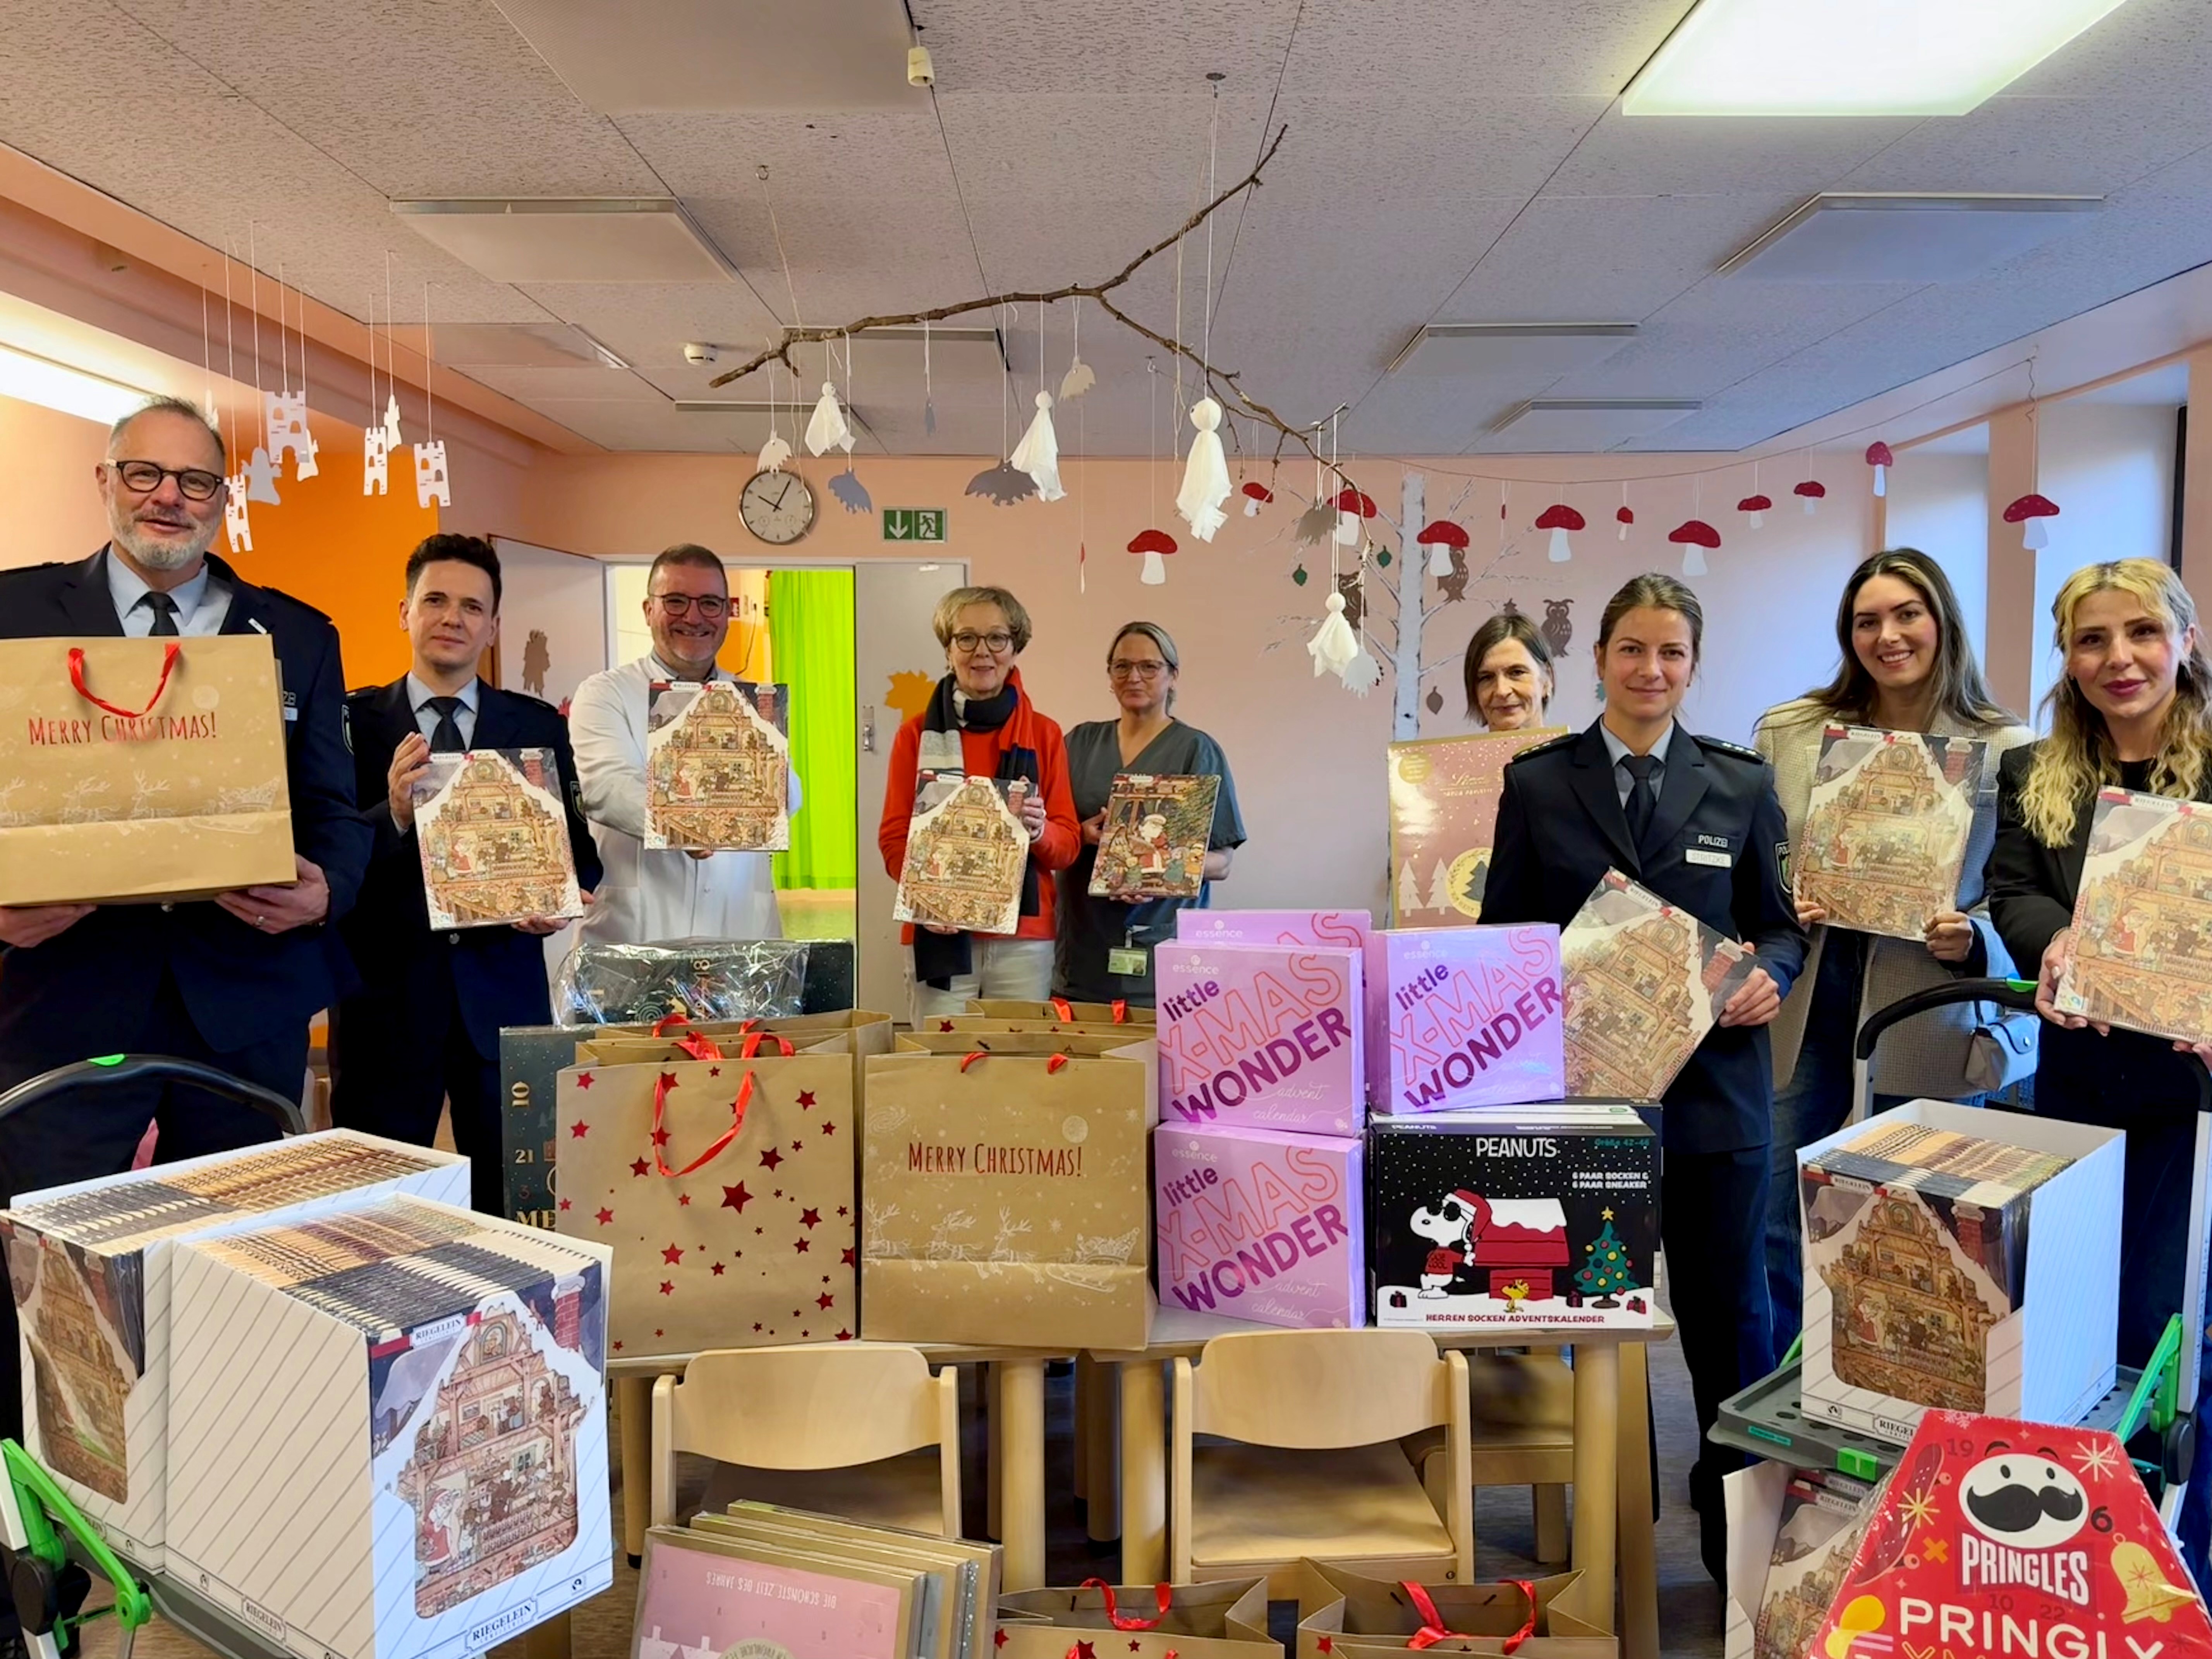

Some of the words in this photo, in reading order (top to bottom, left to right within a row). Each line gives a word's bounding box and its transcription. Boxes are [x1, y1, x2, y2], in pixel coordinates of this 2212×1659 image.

[29, 717, 91, 745] MERRY
[101, 712, 217, 743] CHRISTMAS!
[1697, 835, 1729, 848] POLIZEI
[1195, 929, 1243, 938] essence
[1404, 950, 1448, 960] essence
[1173, 964, 1219, 975] essence
[1395, 965, 1449, 1011] little
[1163, 980, 1220, 1022] little
[1389, 927, 1553, 1086] X-MAS
[1158, 953, 1341, 1095] X-MAS
[1404, 977, 1562, 1108] WONDER
[1172, 1007, 1351, 1123] WONDER
[1278, 1082, 1329, 1100] advent
[1253, 1104, 1311, 1124] calendar
[515, 1149, 534, 1164] 21
[1171, 1149, 1218, 1163] essence
[1475, 1137, 1558, 1158] PEANUTS
[908, 1142, 966, 1173] MERRY
[974, 1143, 1082, 1177] CHRISTMAS!
[1579, 1171, 1604, 1180] PAAR
[1605, 1171, 1641, 1180] SOCKEN
[519, 1184, 530, 1199] 3
[1163, 1168, 1218, 1207] little
[1159, 1146, 1338, 1283] X-MAS
[1172, 1204, 1348, 1312] WONDER
[1277, 1279, 1328, 1298] advent
[1251, 1298, 1308, 1320] calendar
[1426, 1314, 1465, 1322] HERREN
[1467, 1314, 1506, 1322] SOCKEN
[1508, 1314, 1605, 1323] ADVENTSKALENDER
[416, 1319, 461, 1340] RIEGELEIN
[1946, 1438, 1974, 1457] 19
[2091, 1505, 2113, 1533] 6
[1961, 1532, 2090, 1606] PRINGLES
[706, 1571, 735, 1588] JAHRES
[737, 1583, 753, 1592] DES
[755, 1583, 774, 1597] ZEIT
[823, 1593, 837, 1609] DIE
[1989, 1594, 2013, 1611] 10
[246, 1602, 282, 1632] RIEGELEIN
[473, 1605, 531, 1641] RIEGELEIN
[2040, 1604, 2066, 1622] 22
